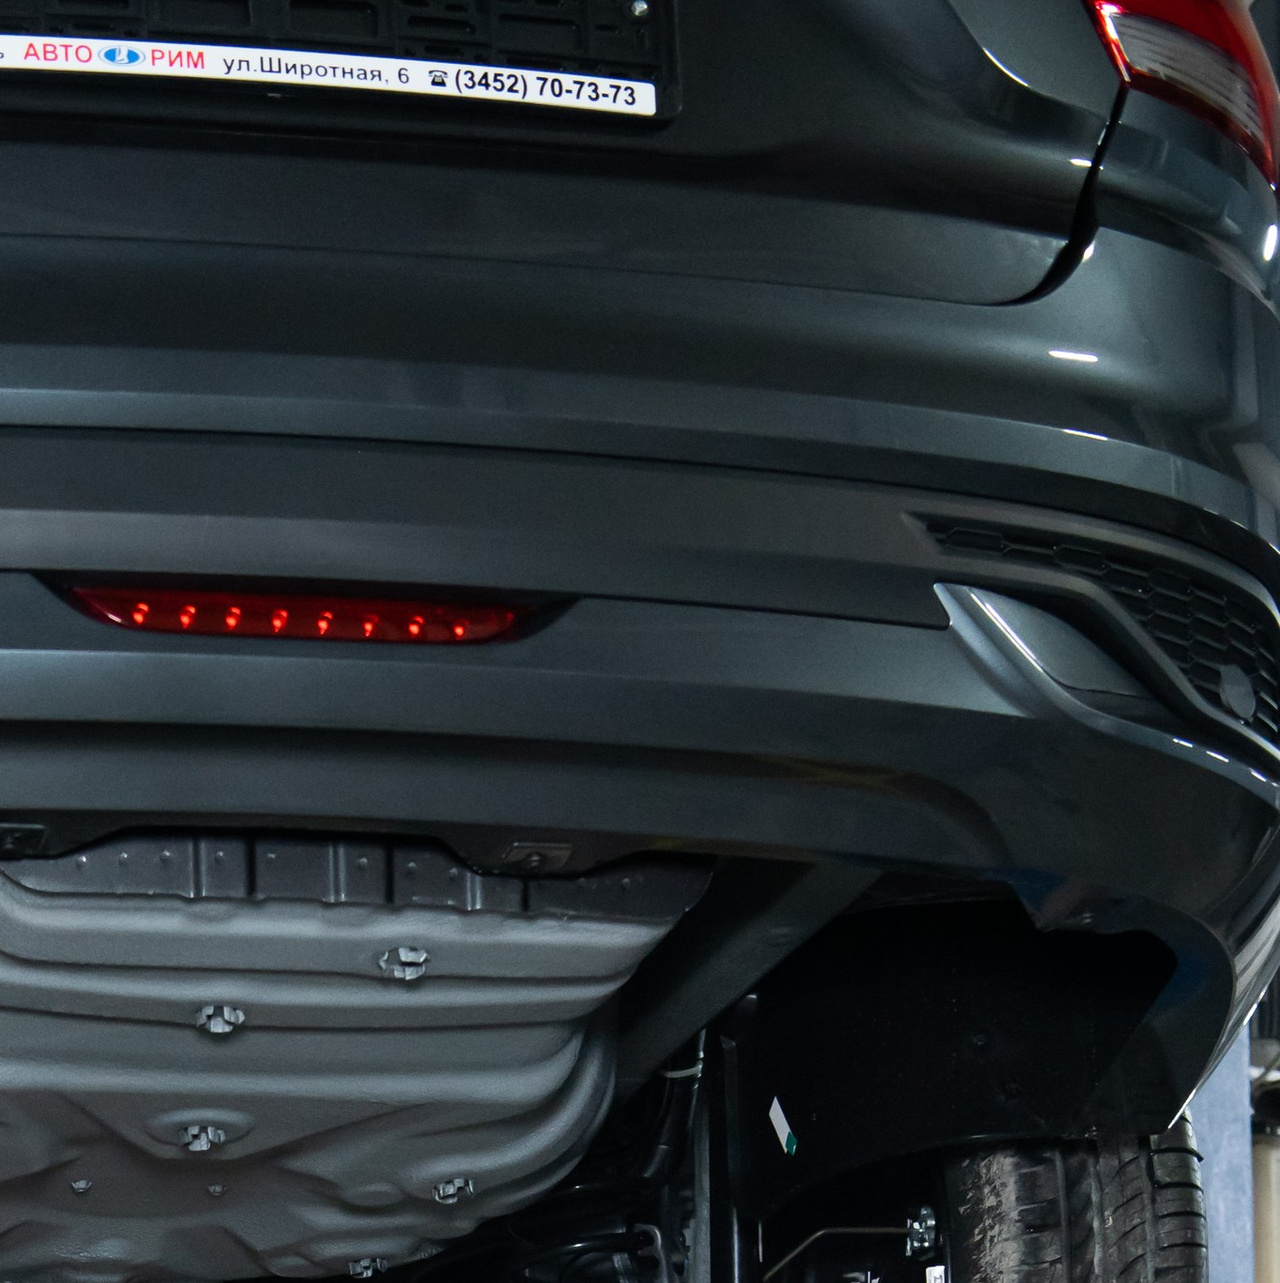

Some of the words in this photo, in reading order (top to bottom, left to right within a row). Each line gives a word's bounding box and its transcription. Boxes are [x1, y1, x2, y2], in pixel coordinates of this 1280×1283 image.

[23, 42, 93, 64] АВТО
[151, 48, 205, 69] РИМ
[397, 66, 410, 84] 6
[454, 69, 528, 99] (3452)
[536, 77, 637, 106] 70-73-73
